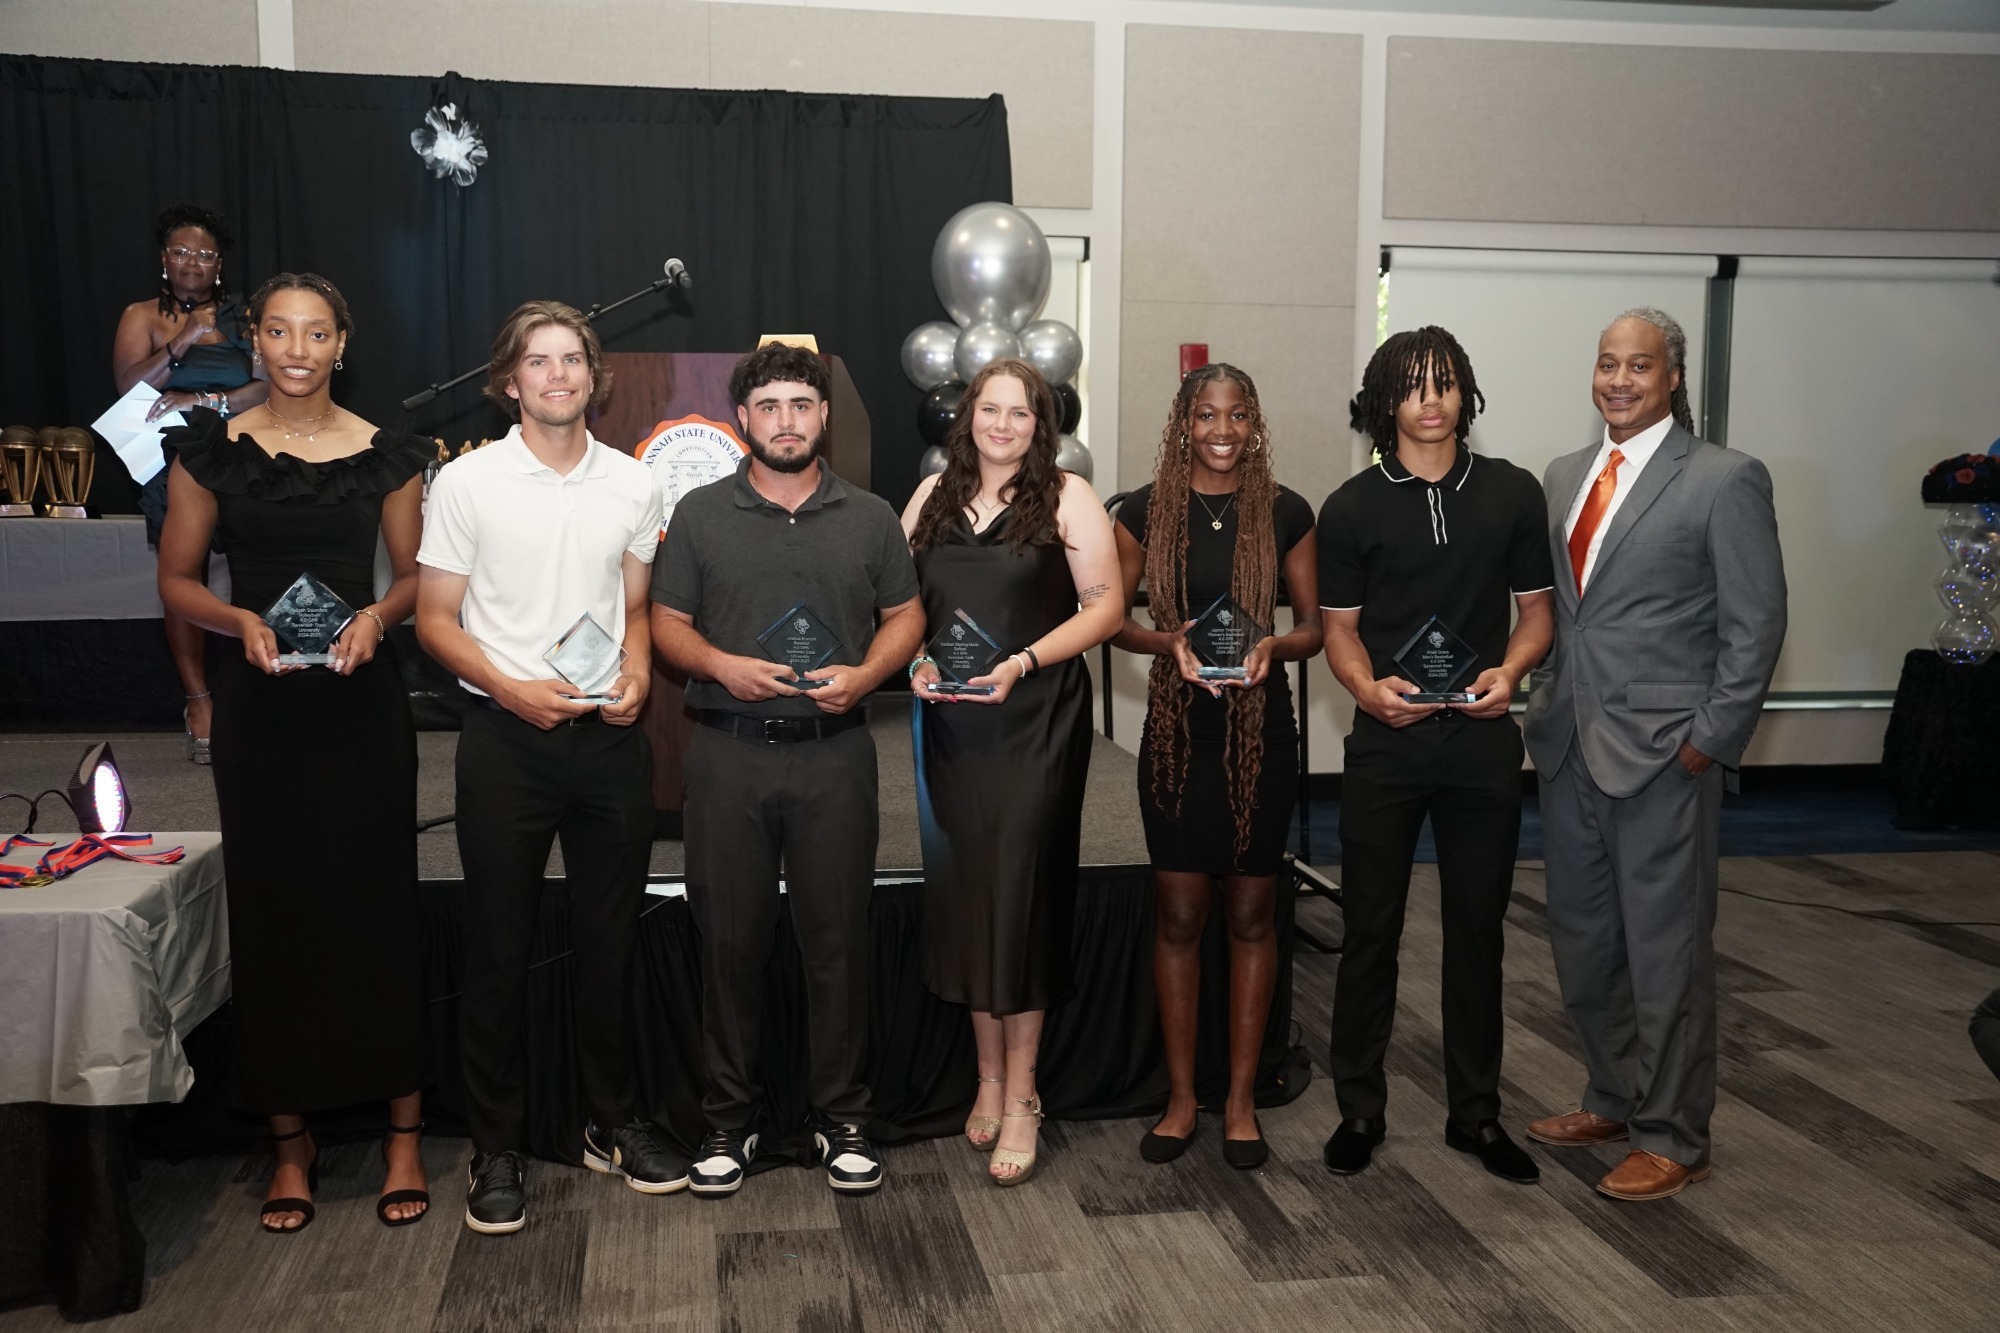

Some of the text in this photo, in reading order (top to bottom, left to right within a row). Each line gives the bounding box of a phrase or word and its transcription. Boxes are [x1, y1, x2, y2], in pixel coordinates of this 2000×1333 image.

[646, 428, 740, 468] ANNAH STATE UNIVER
[676, 446, 712, 458] CONSTITUTION
